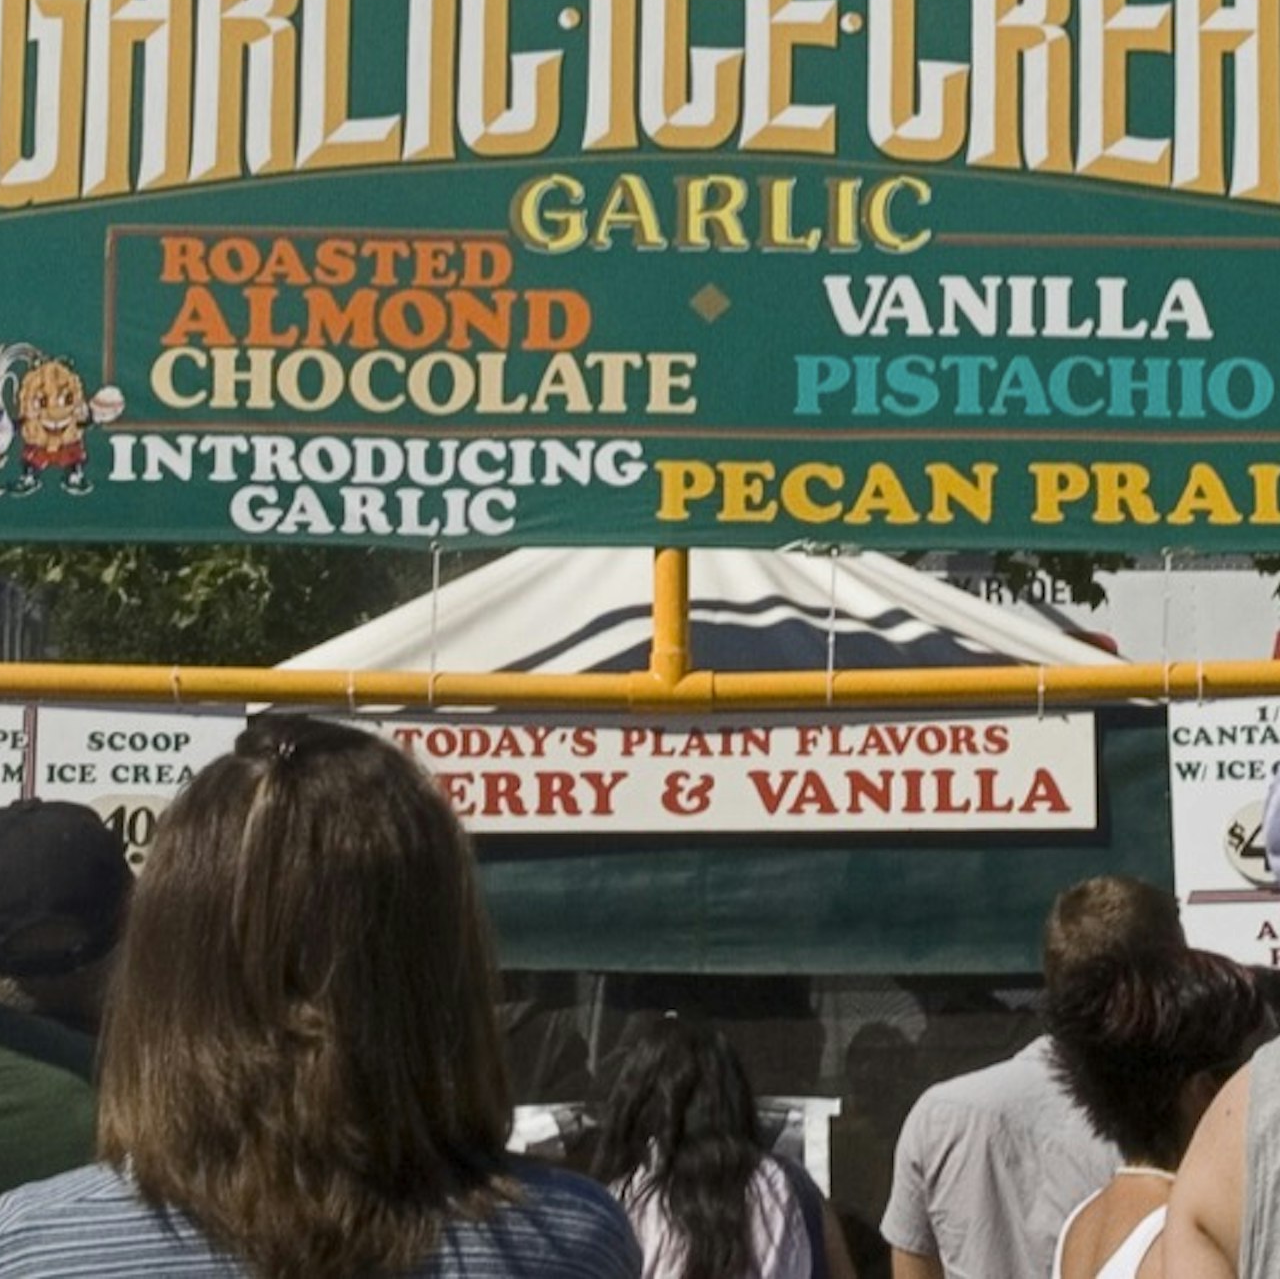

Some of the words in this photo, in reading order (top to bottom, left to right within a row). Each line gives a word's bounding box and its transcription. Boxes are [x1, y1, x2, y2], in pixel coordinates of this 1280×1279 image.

[511, 174, 932, 255] GARLIC
[159, 237, 514, 288] ROASTED
[159, 285, 592, 351] ALMOND
[824, 274, 1213, 341] VANILLA
[150, 348, 697, 415] CHOCOLATE
[793, 354, 1275, 421] PISTACHIO
[109, 435, 647, 487] INTRODUCING
[230, 486, 517, 537] GARLIC
[655, 459, 998, 524] PECAN
[87, 731, 190, 752] SCOOP
[393, 726, 597, 758] TODAY'S
[620, 726, 771, 757] PLAIN
[795, 725, 1010, 755] FLAVORS
[46, 763, 96, 784] ICE
[111, 763, 194, 785] CREA
[438, 771, 627, 817] ERRY
[661, 771, 715, 815] &
[747, 766, 1070, 815] VANILLA
[1217, 759, 1265, 781] ICE
